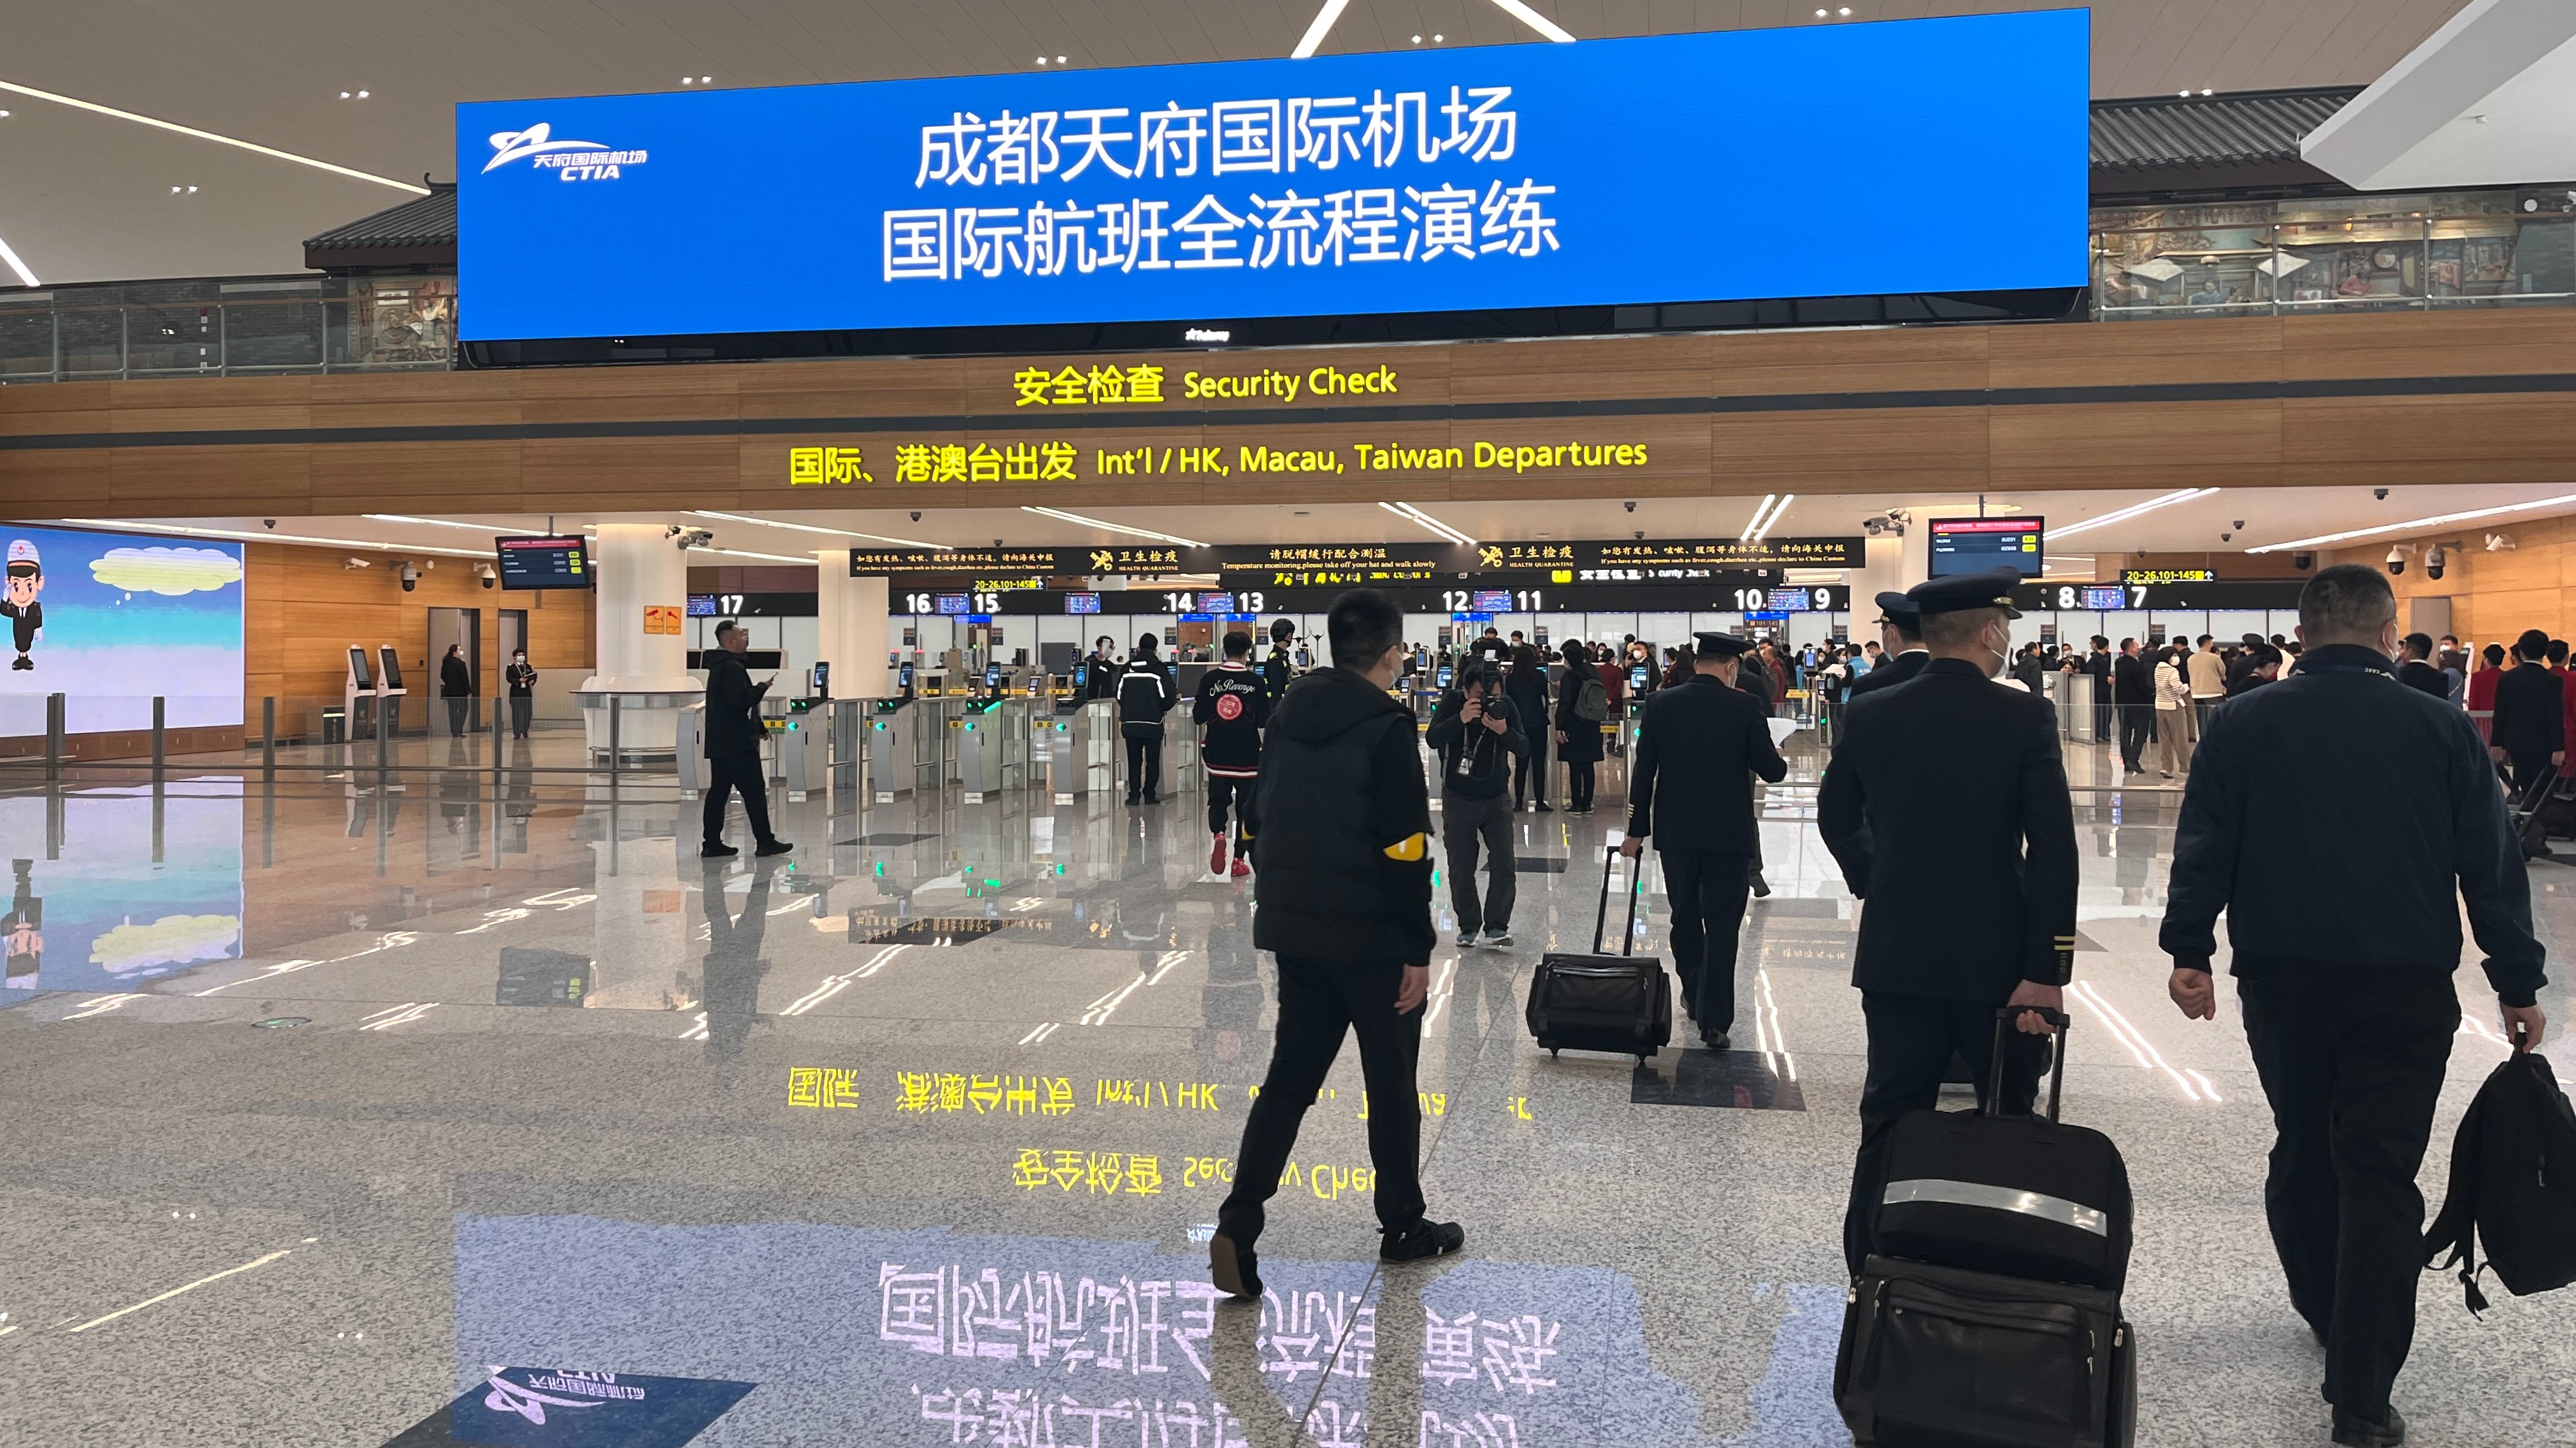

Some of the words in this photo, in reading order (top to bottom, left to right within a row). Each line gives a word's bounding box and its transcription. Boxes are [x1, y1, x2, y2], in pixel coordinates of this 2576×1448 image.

[915, 85, 1519, 188] 成都天府国际机场
[533, 150, 648, 169] 天府国际机场
[560, 165, 619, 181] CTIA
[883, 177, 1560, 282] 国际航班全流程演练
[1014, 363, 1164, 406] 安全检查
[1184, 369, 1301, 403] Security
[1309, 364, 1398, 395] Check
[790, 440, 1078, 485] 国际、港澳台出发
[1180, 447, 1229, 477] HK,
[1240, 446, 1344, 474] Macau,
[1353, 442, 1463, 470] Taiwan
[1474, 441, 1648, 474] Departures
[1119, 549, 1178, 563] 卫生检疫
[1509, 545, 1574, 559] 卫生检疫
[1221, 562, 1264, 570] Temperature
[1412, 560, 1436, 569] slowly
[721, 595, 744, 614] 17
[906, 593, 931, 613] 16
[974, 593, 999, 613] 15
[1167, 592, 1192, 612] 14
[1239, 592, 1264, 612] 13
[1443, 590, 1468, 611] 12
[1517, 590, 1541, 610] 11
[1734, 588, 1762, 610] 10
[1814, 588, 1831, 609] 9
[2059, 586, 2075, 608] 8
[2131, 586, 2147, 608] 7
[1209, 679, 1223, 697] No
[1222, 679, 1256, 694] Revenge
